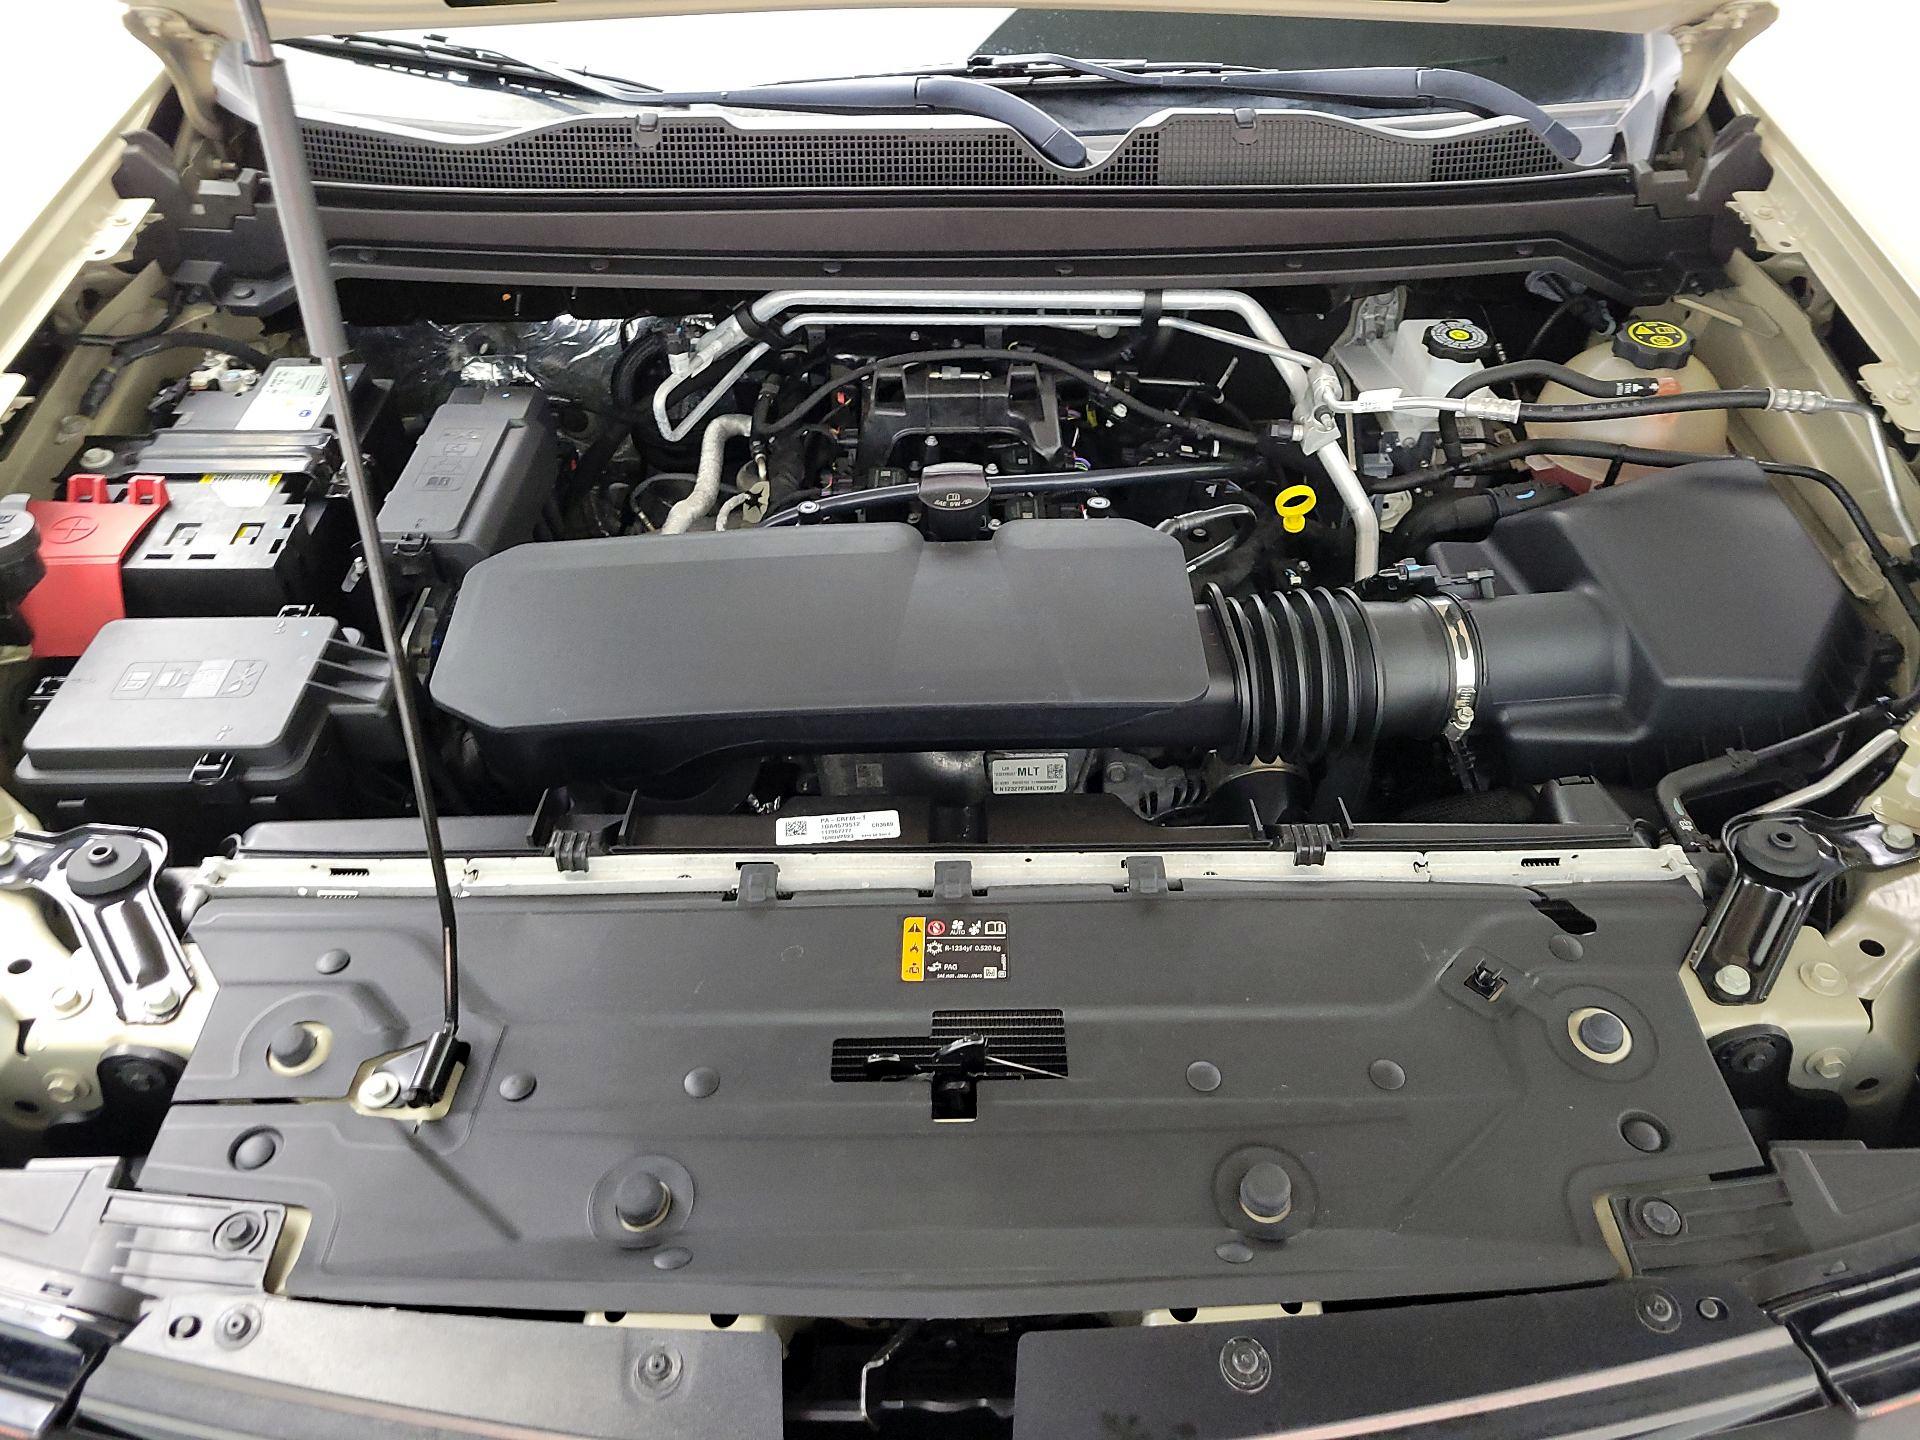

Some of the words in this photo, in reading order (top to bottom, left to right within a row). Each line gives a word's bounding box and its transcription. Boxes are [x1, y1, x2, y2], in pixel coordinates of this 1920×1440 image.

[1017, 766, 1040, 777] MLT
[944, 944, 973, 953] R-1234yf
[992, 944, 1002, 953] kg
[943, 963, 958, 971] PAG
